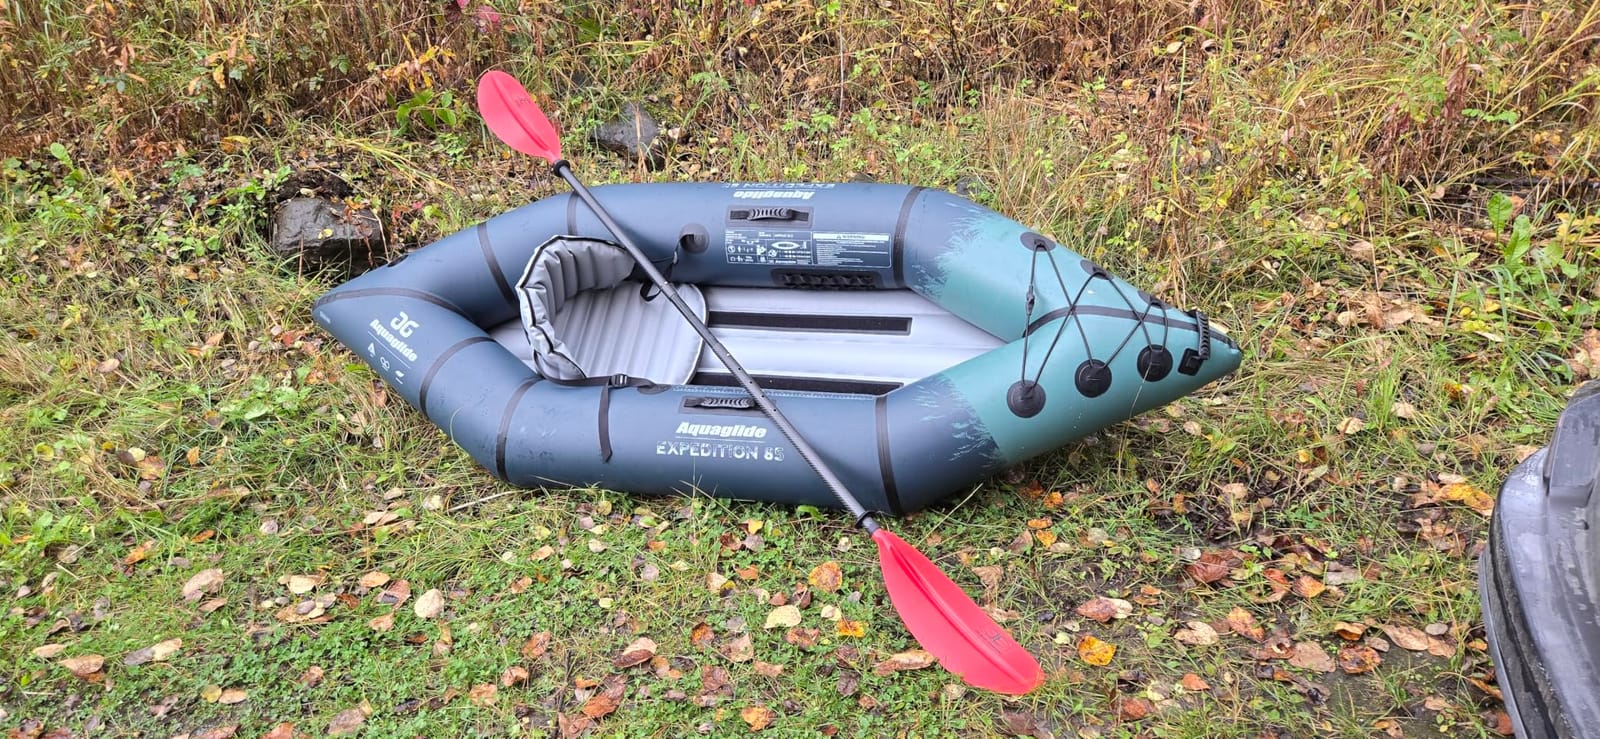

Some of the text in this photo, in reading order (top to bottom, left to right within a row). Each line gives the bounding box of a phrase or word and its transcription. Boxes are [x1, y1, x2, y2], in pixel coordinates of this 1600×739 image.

[733, 190, 815, 200] Aquaglide
[369, 319, 418, 362] Aquaglide
[675, 422, 768, 439] Aquaglide
[656, 440, 785, 462] EXPEDITION 85
